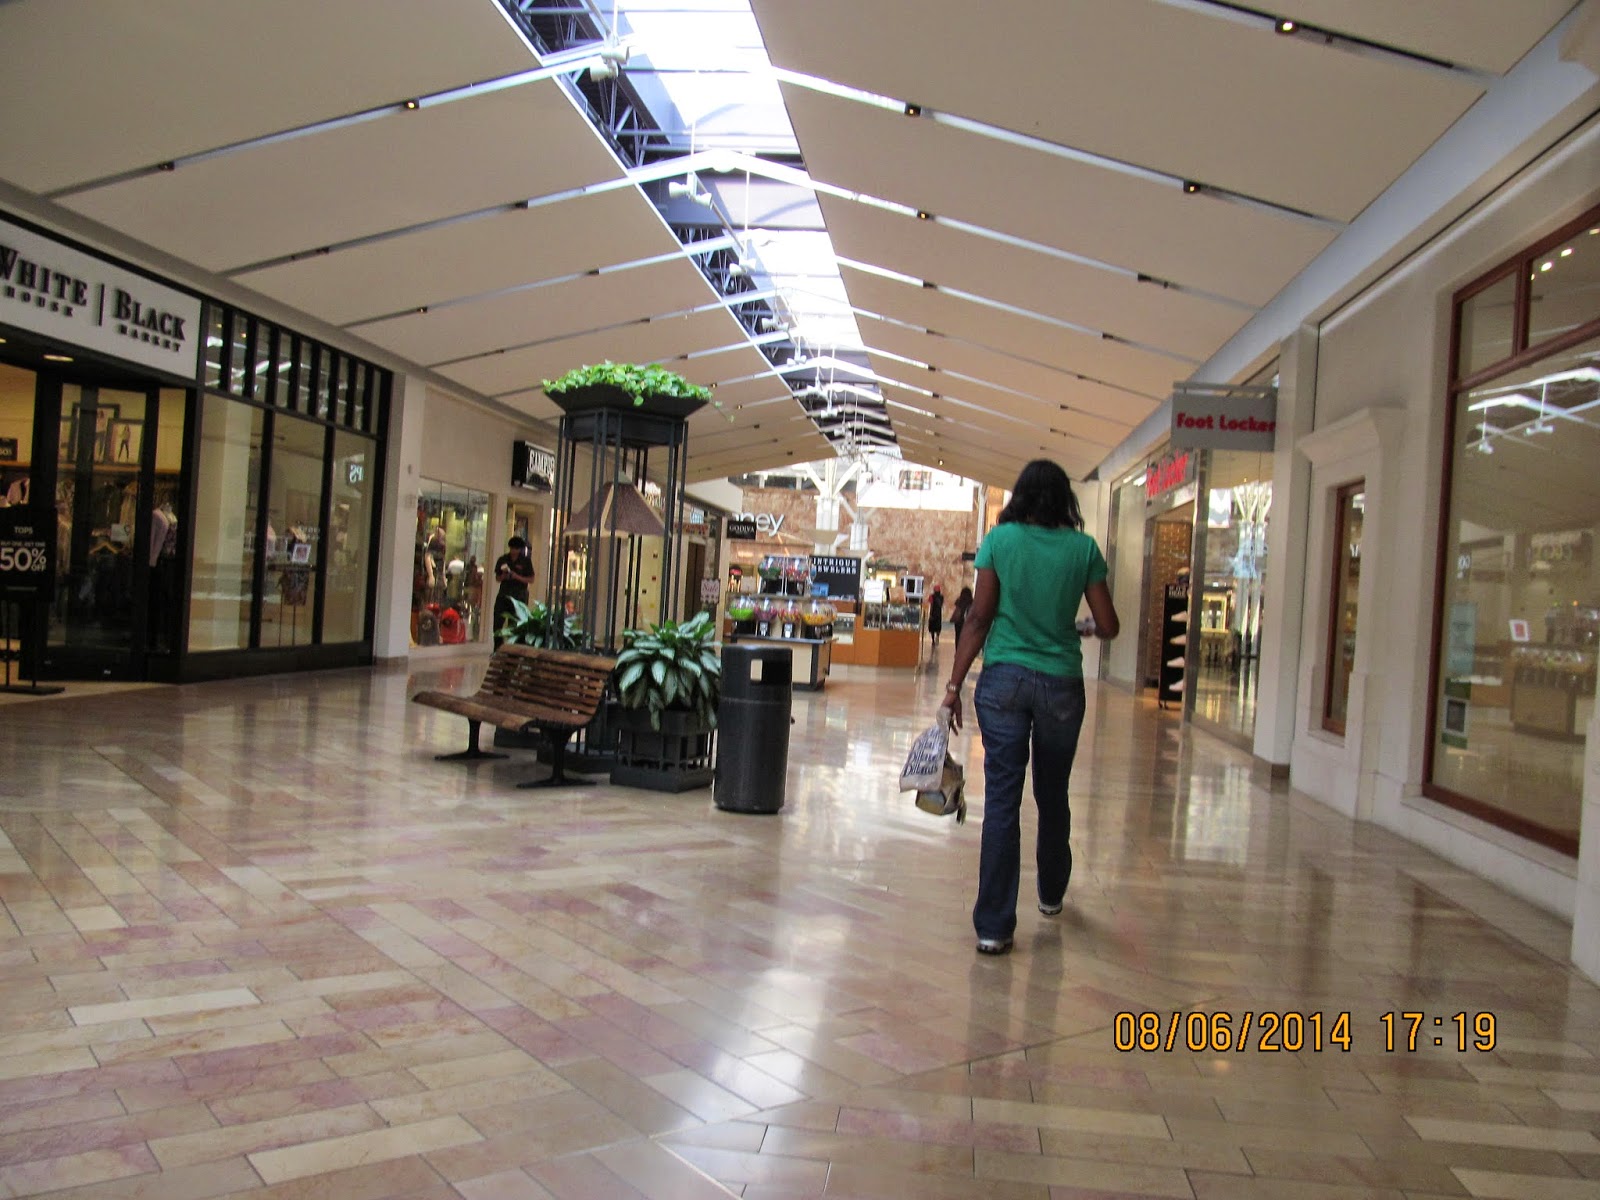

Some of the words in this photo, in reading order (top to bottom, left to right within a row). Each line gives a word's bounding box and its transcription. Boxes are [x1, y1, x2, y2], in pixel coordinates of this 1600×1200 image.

[0, 246, 88, 307] WHITE
[113, 287, 187, 341] BLACK
[118, 324, 182, 352] MARKET
[1176, 412, 1214, 430] Foot
[1219, 414, 1276, 433] Locker
[733, 511, 785, 537] ney
[0, 547, 47, 571] 50%
[815, 565, 857, 575] EWELERS
